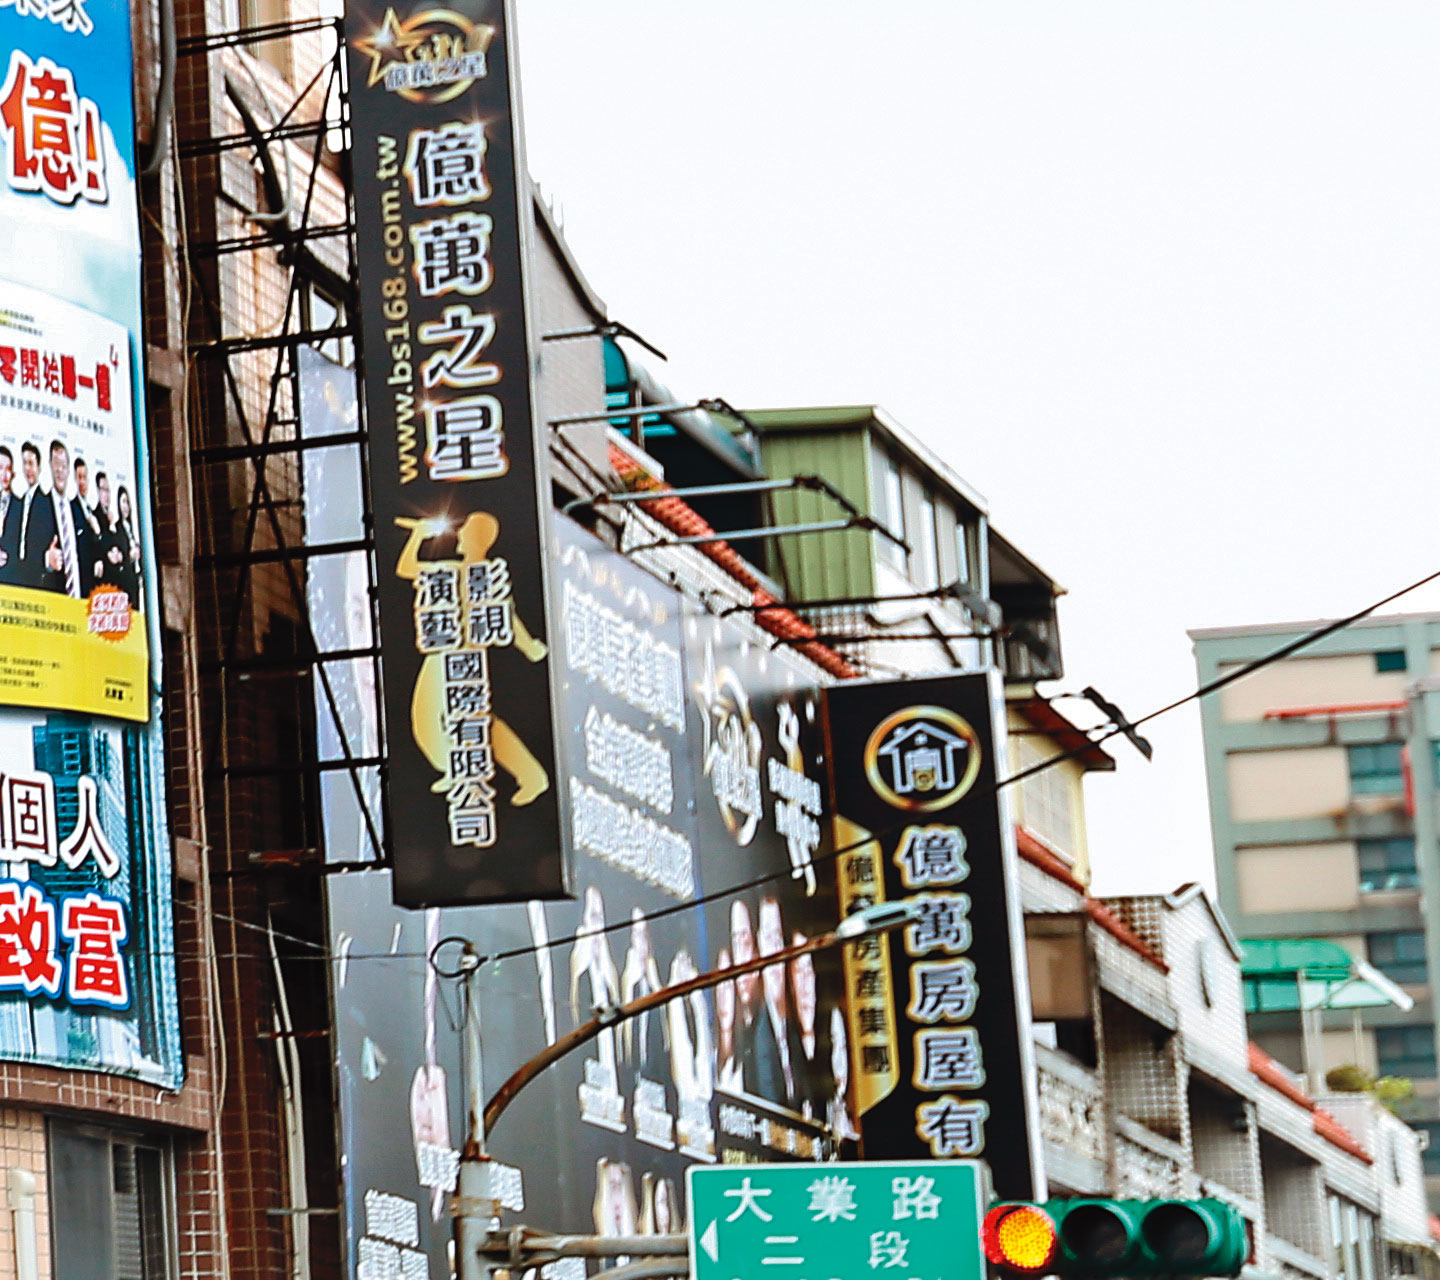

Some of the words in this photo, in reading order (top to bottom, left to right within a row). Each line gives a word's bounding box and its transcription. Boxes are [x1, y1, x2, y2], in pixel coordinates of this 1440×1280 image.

[383, 134, 417, 484] www.bs168.com.tw
[407, 125, 507, 482] 億萬之星
[414, 564, 462, 651] 演藝
[466, 560, 515, 648] 影視
[444, 647, 499, 847] 國際有限公司
[724, 1175, 943, 1223] 大業路
[761, 1230, 911, 1270] 二段
